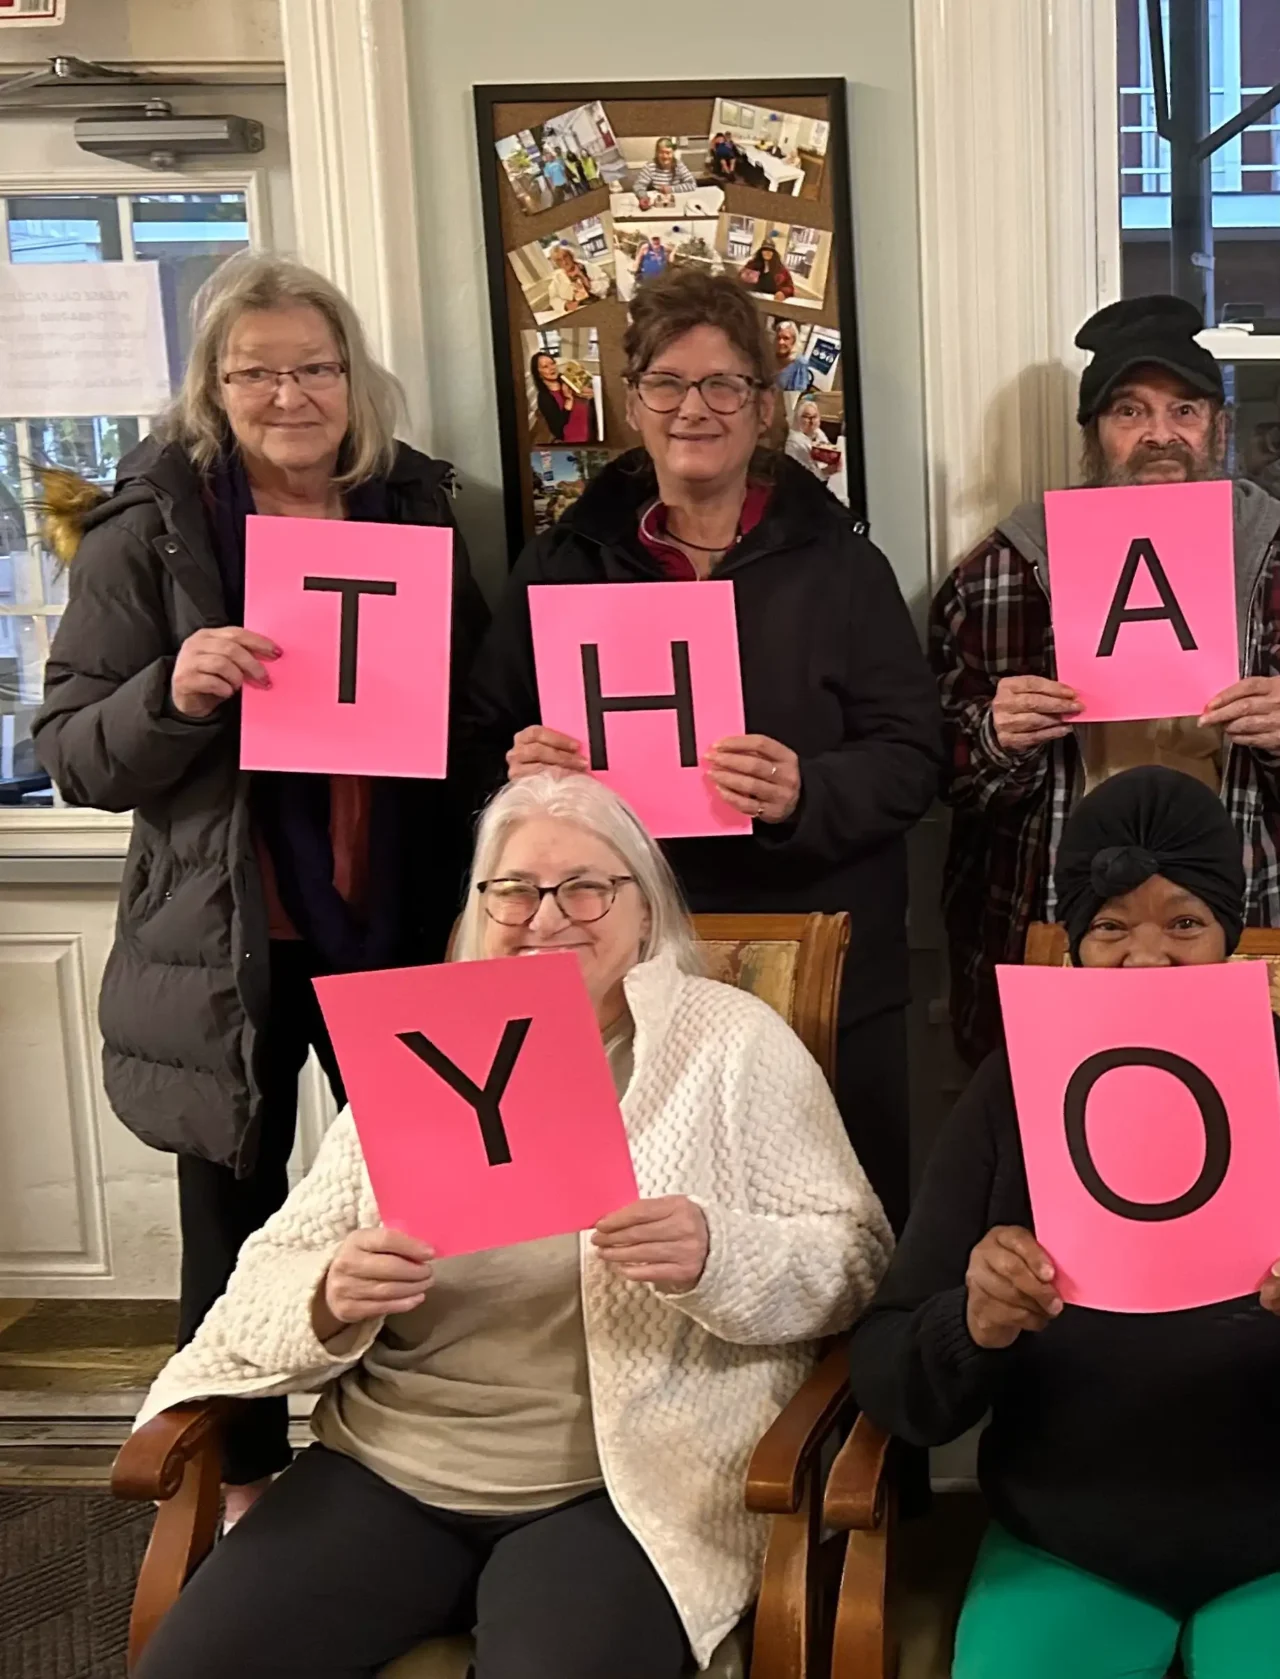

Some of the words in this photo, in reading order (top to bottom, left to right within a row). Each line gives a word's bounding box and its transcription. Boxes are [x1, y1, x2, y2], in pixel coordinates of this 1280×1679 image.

[303, 577, 396, 704] T
[1097, 539, 1198, 657] A
[581, 641, 698, 771] H
[397, 1018, 532, 1166] Y
[1064, 1048, 1232, 1222] O
